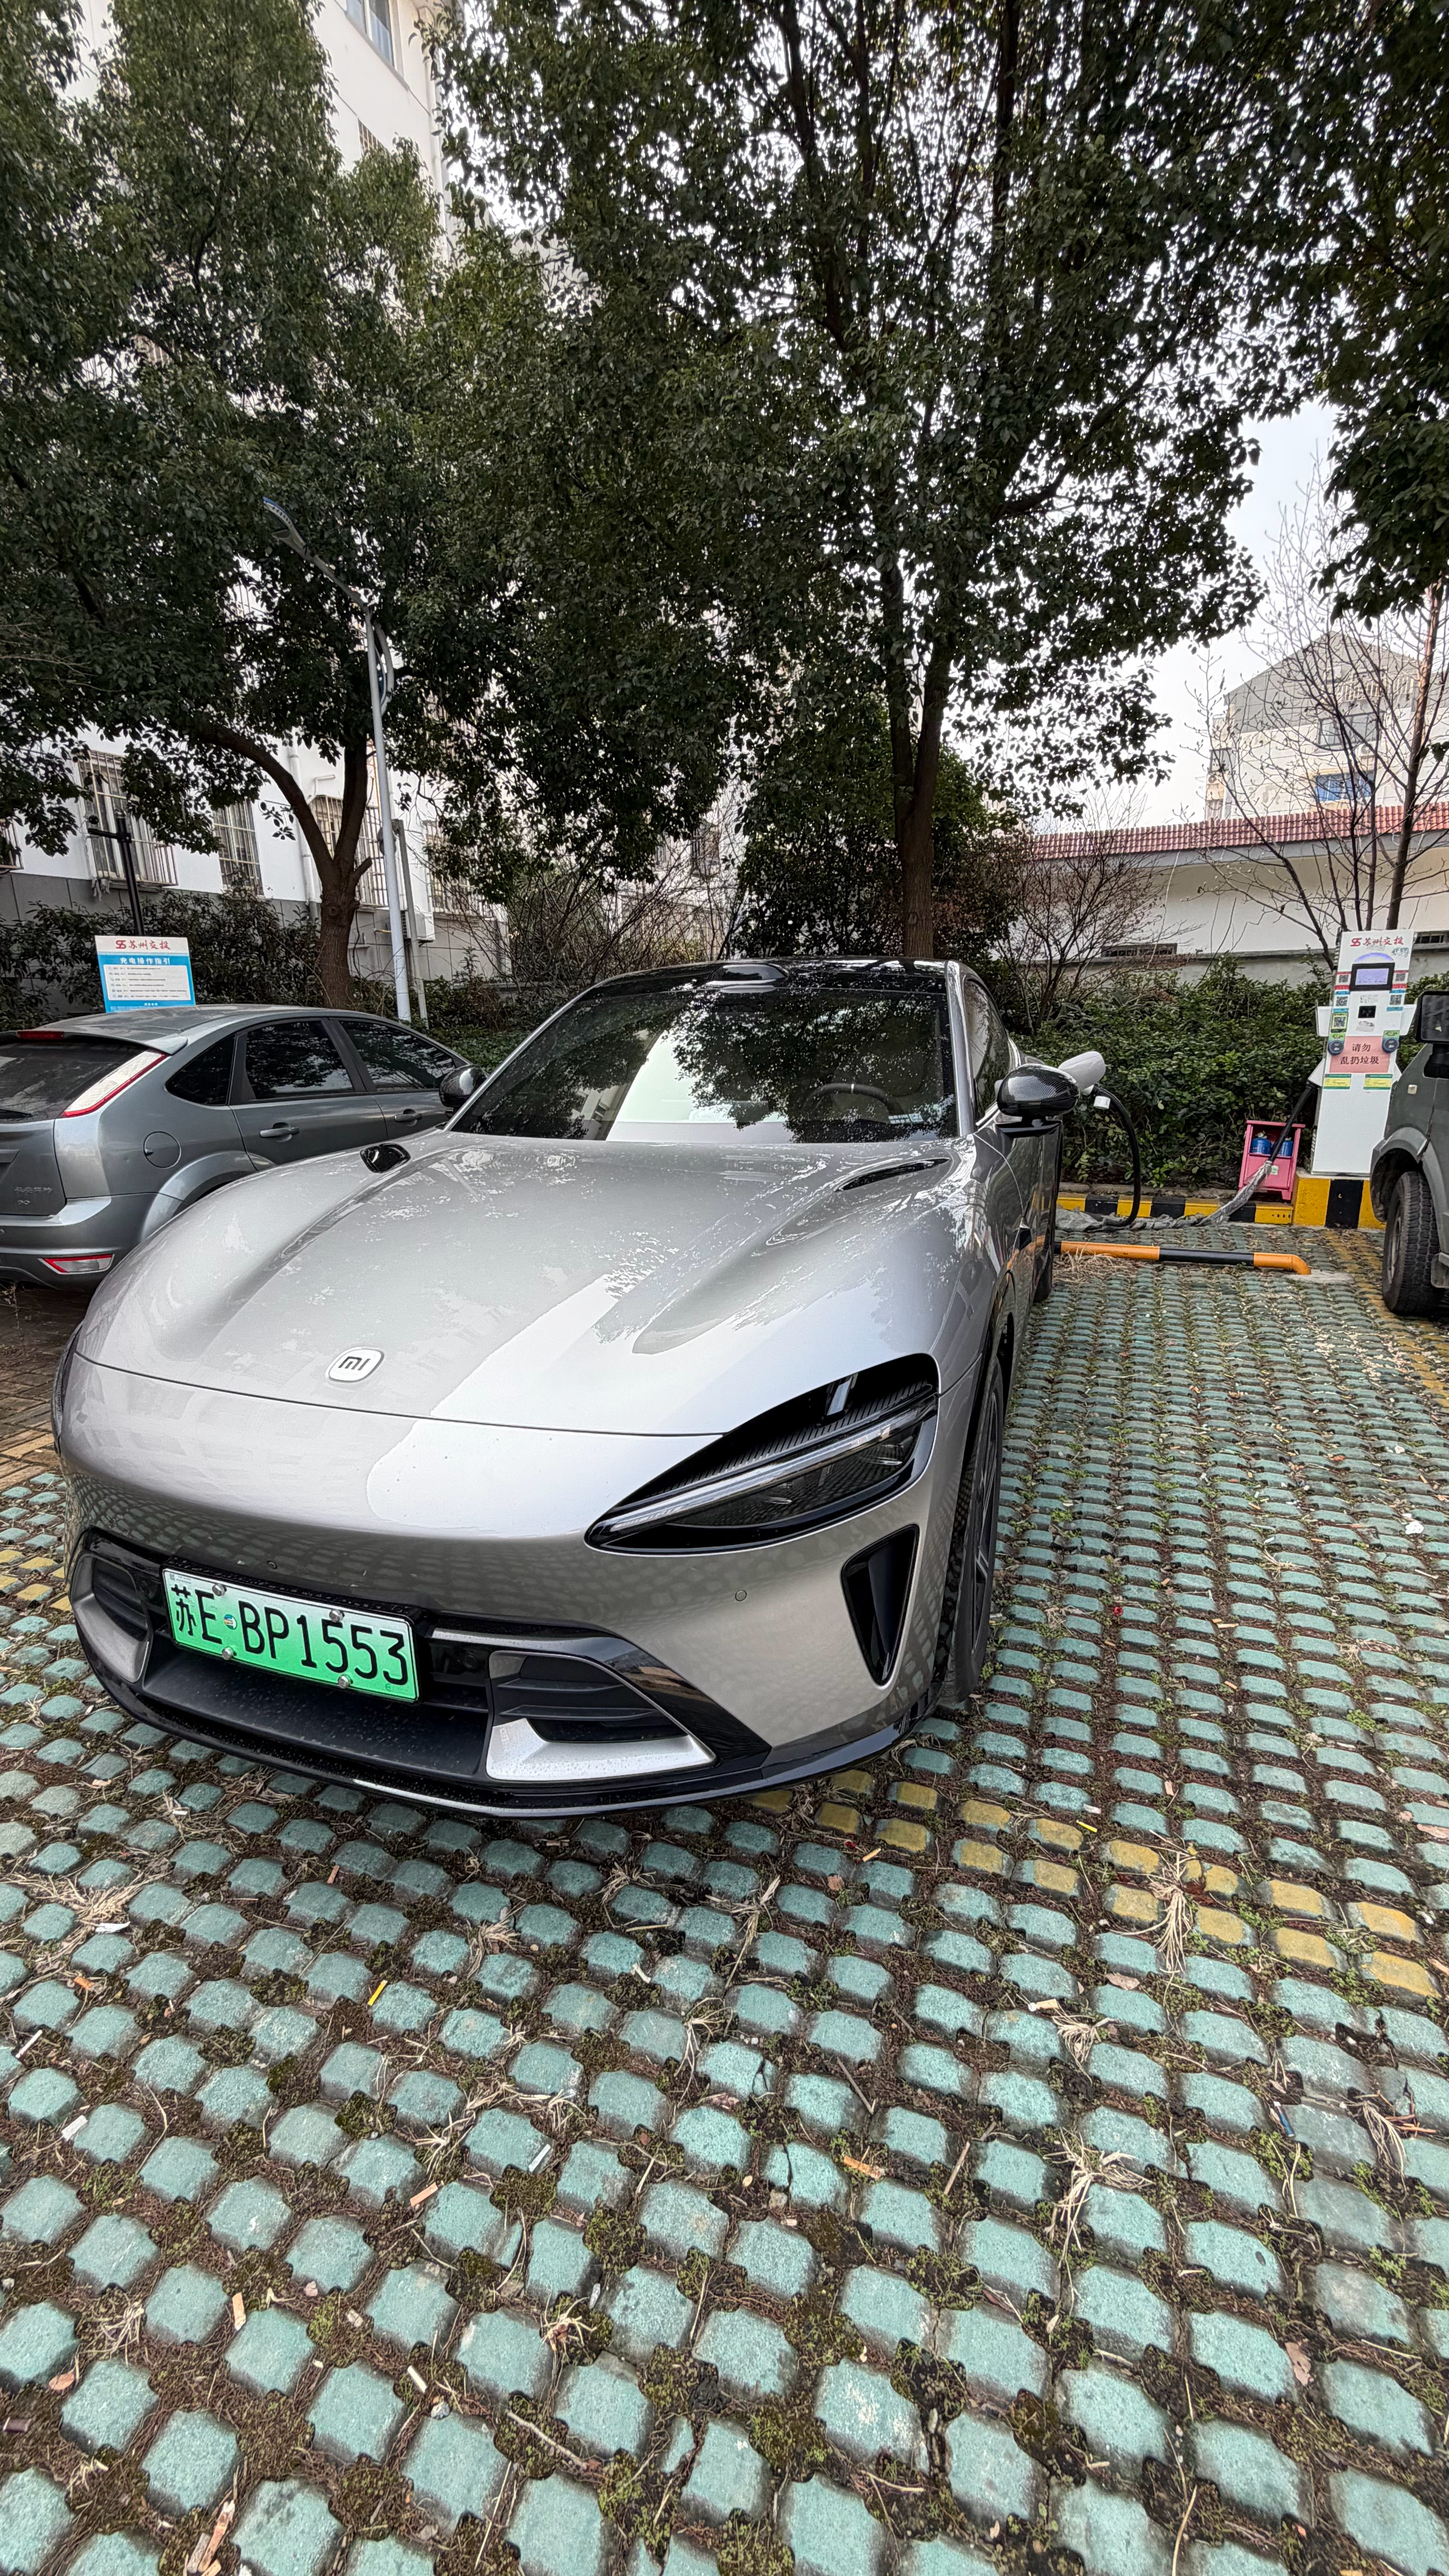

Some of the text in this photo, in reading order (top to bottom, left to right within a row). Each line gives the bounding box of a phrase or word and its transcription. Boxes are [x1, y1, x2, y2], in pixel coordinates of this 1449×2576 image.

[129, 940, 171, 950] 苏州交投
[1363, 936, 1404, 946] 苏州交投
[120, 957, 170, 965] 充电操作指引
[1352, 1043, 1371, 1052] 请勿
[1340, 1056, 1379, 1065] 乱扔垃圾
